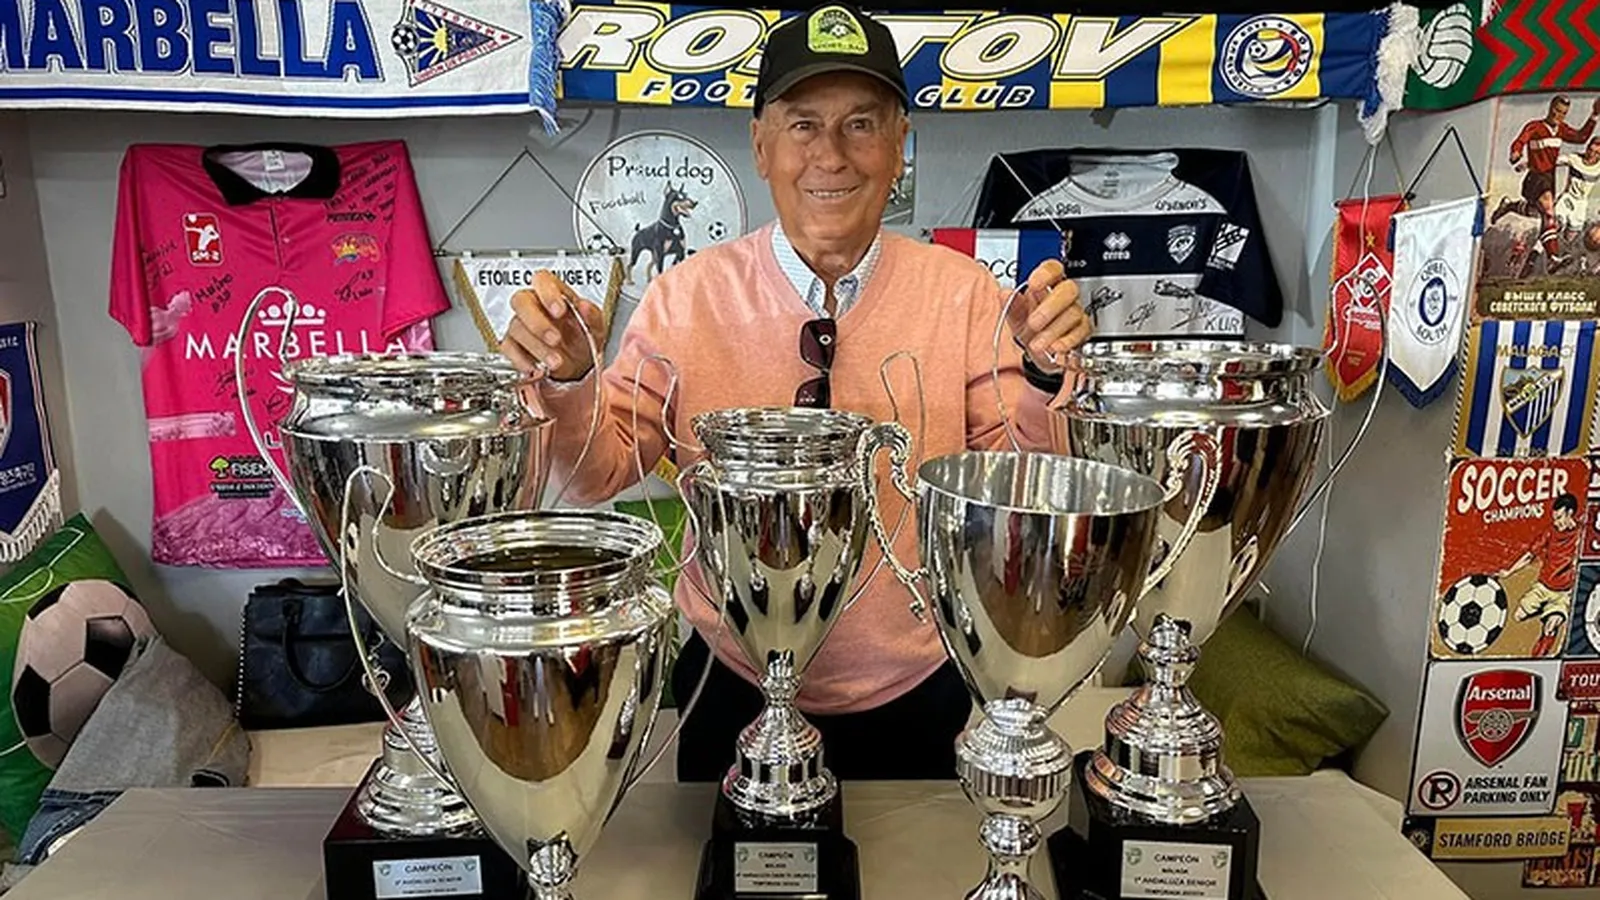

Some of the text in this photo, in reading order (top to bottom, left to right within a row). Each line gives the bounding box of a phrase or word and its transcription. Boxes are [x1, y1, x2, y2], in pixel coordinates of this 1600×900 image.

[556, 6, 1202, 81] ROTOV
[914, 85, 1035, 107] CLUB
[608, 156, 714, 185] Proud dog
[589, 191, 647, 215] Football
[479, 269, 521, 286] ETOILE
[587, 269, 602, 285] FC
[1457, 464, 1569, 514] SOCCER
[1483, 502, 1544, 524] CHAMPIONS
[1468, 684, 1531, 700] Arsenal
[1464, 775, 1548, 789] ARSENAL FAN
[1463, 790, 1551, 804] PARKING ONLY
[1439, 831, 1566, 848] STAMFORD BRIDGE
